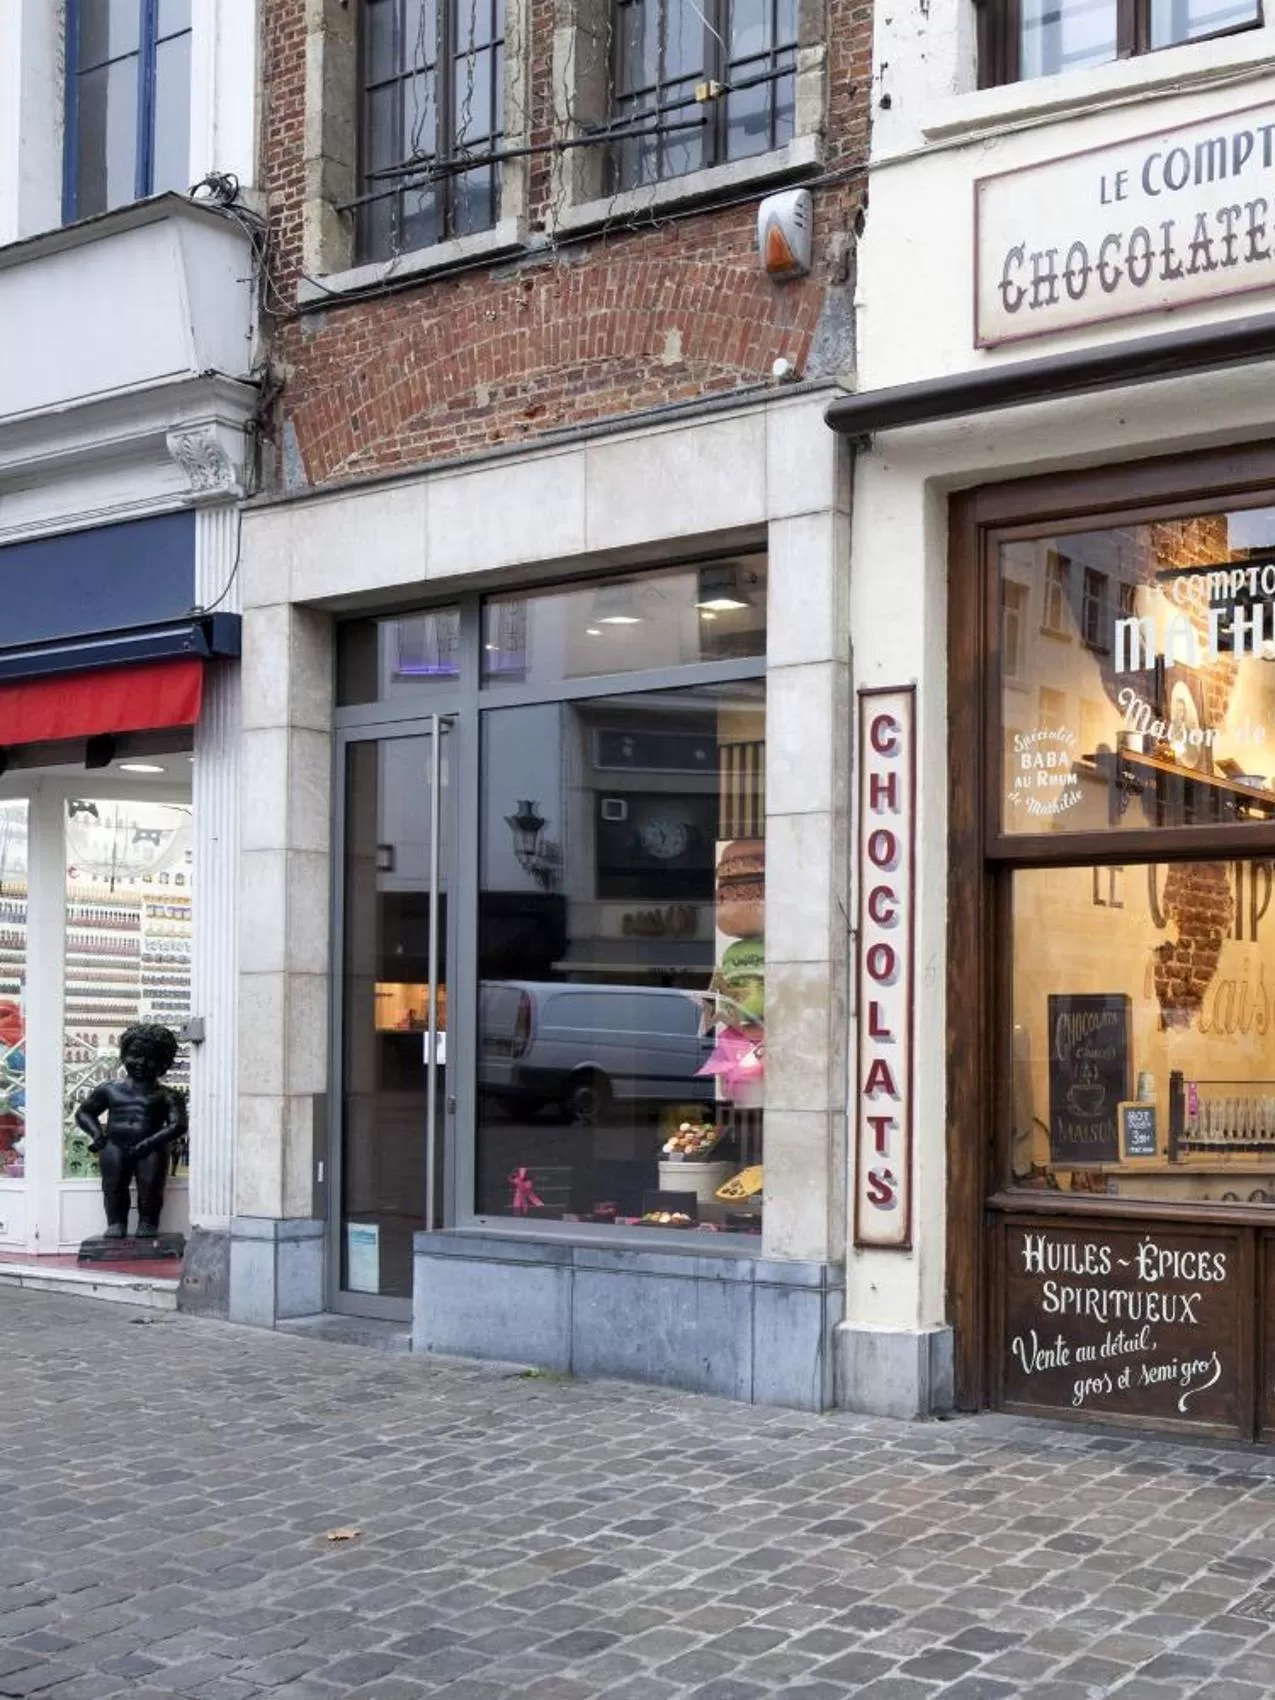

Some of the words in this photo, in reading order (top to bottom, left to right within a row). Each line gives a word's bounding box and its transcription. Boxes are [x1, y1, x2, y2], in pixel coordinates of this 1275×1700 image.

[1100, 169, 1129, 205] LE
[1118, 687, 1221, 747] Maison
[1015, 775, 1031, 788] AU
[1037, 769, 1078, 787] RHUM
[1021, 752, 1069, 769] BABA
[864, 714, 900, 1210] CHOCOLATS
[1022, 1234, 1111, 1274] HUILES
[1135, 1235, 1226, 1282] ÉPICES
[1043, 1280, 1202, 1323] SPIRITUEUX
[1012, 1329, 1070, 1374] Vente
[1075, 1345, 1096, 1362] au
[1072, 1373, 1112, 1406] gros
[1118, 1366, 1130, 1390] et
[1138, 1358, 1178, 1385] semi
[1177, 1351, 1222, 1412] gros
